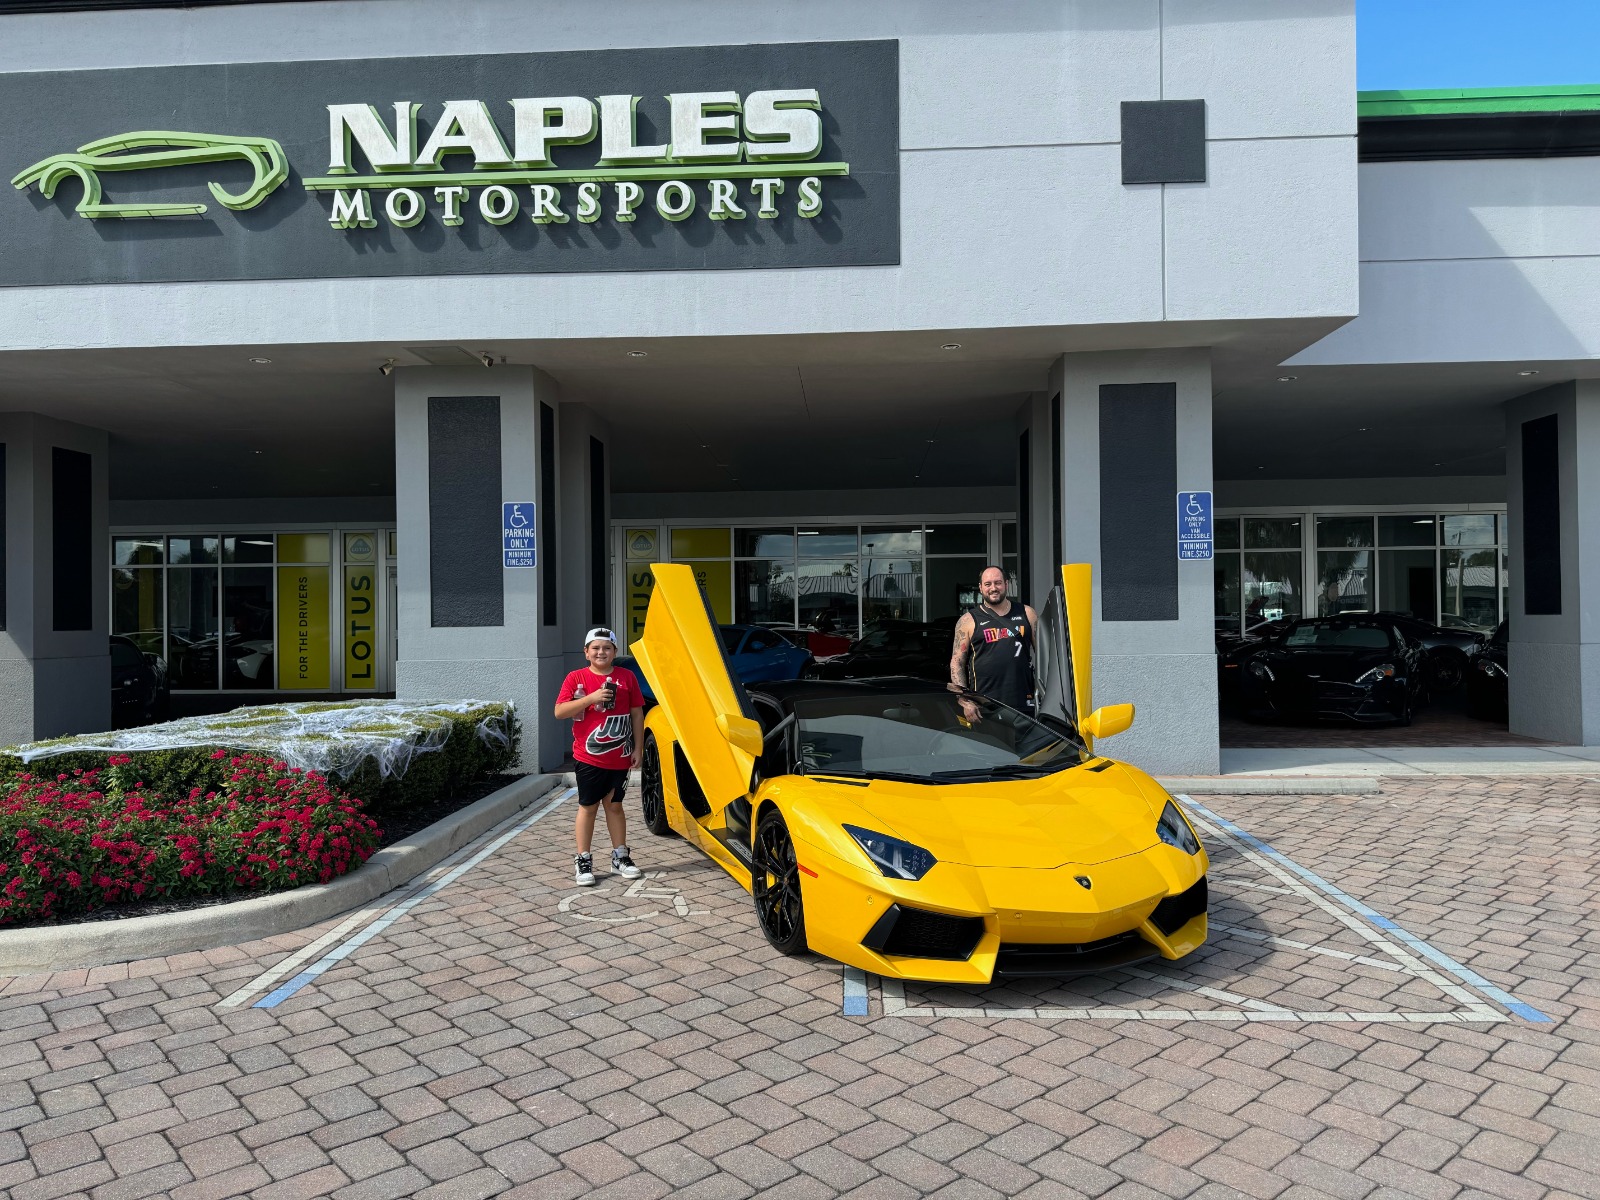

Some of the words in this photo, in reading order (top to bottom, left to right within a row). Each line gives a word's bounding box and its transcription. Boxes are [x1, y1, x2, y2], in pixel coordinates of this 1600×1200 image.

[327, 89, 822, 173] NAPLES
[328, 177, 822, 229] MOTORSPORTS
[504, 528, 534, 538] PARKING
[510, 538, 528, 548] ONLY
[298, 576, 308, 627] DRIVERS
[633, 572, 652, 633] TUS
[299, 630, 308, 654] THE
[351, 575, 371, 679] LOTUS
[299, 656, 308, 679] FOR
[1014, 641, 1023, 657] 7
